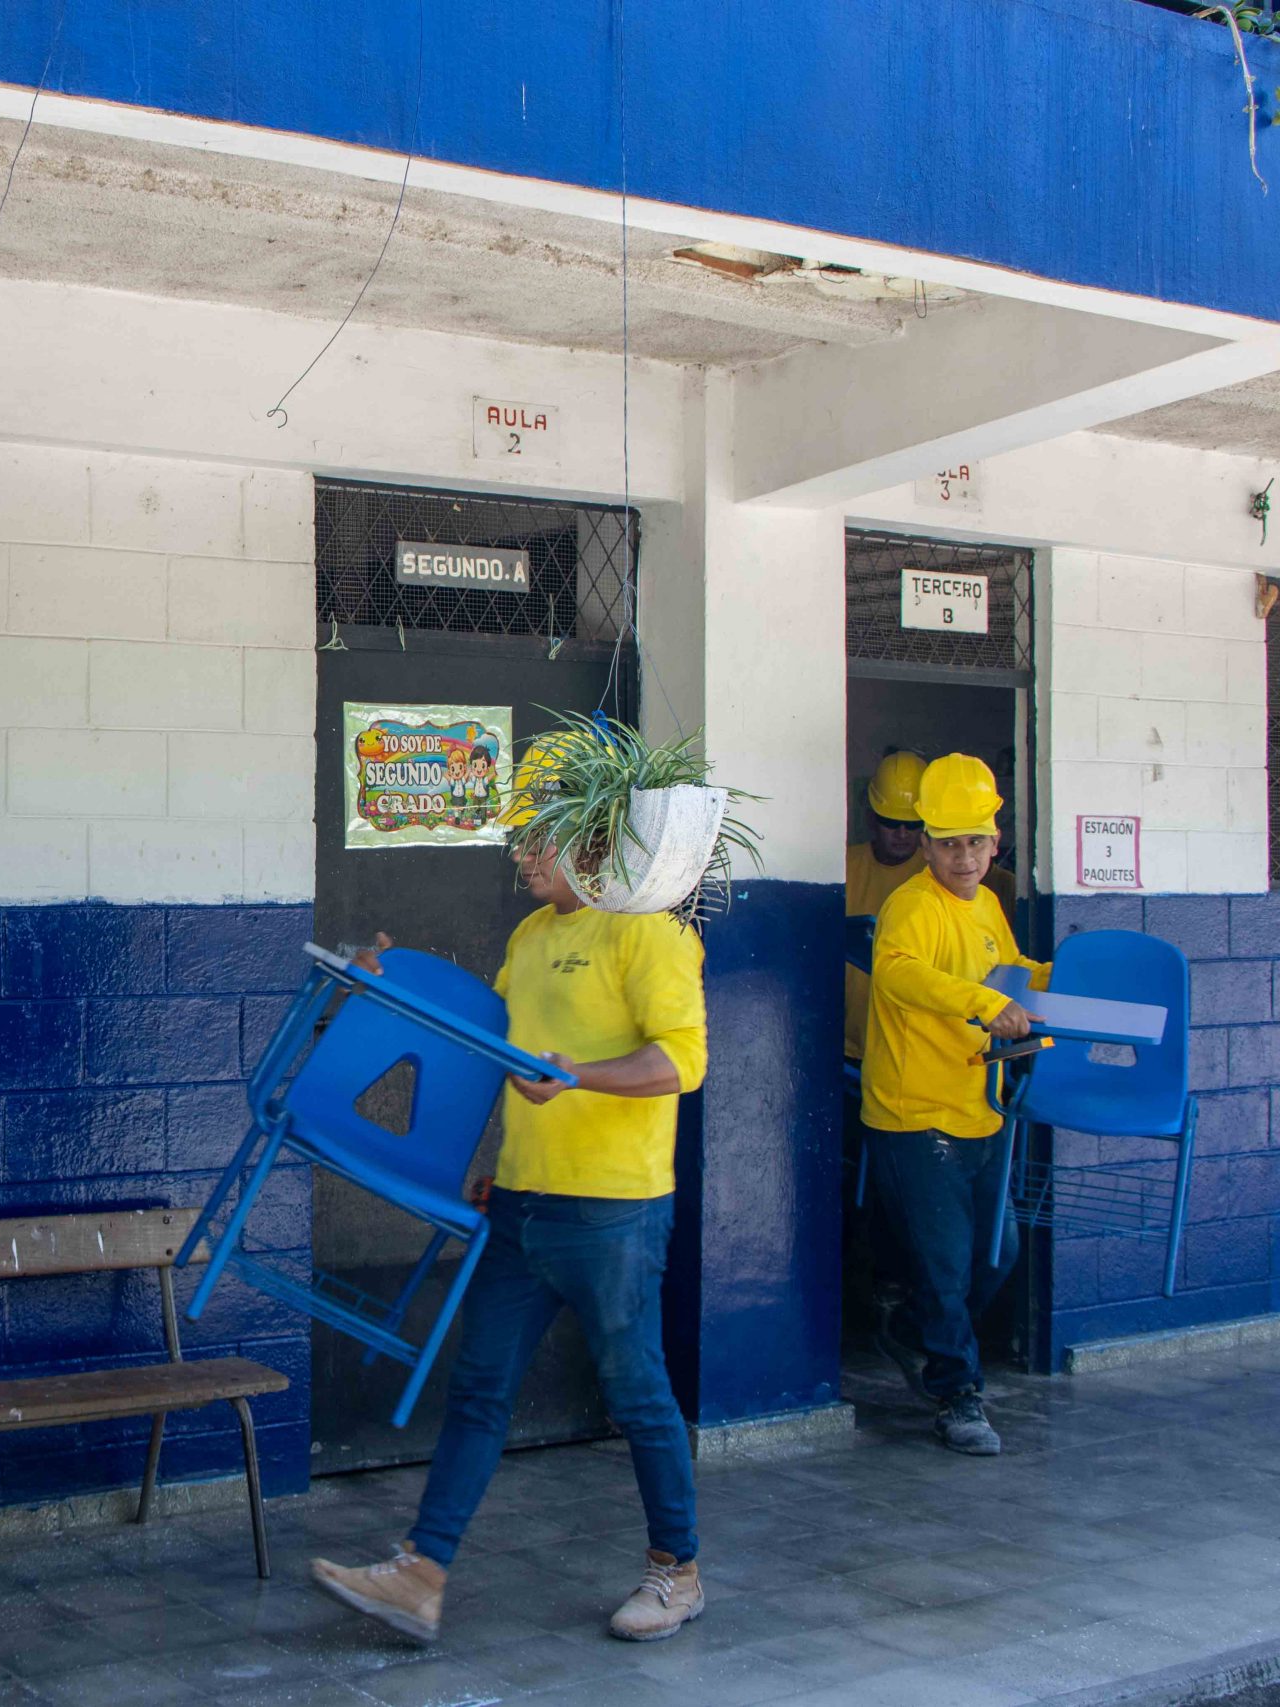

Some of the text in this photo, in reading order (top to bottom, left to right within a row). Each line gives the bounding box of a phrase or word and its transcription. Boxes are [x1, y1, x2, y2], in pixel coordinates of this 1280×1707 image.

[487, 406, 547, 431] AULA
[507, 432, 521, 454] 2
[937, 465, 969, 480] LA
[940, 480, 950, 501] 3
[912, 577, 982, 599] TERCERO
[943, 608, 953, 624] B
[383, 735, 442, 752] YO SOY DE
[365, 762, 442, 786] SEGUNDO
[1084, 820, 1133, 835] ESTACIÓN
[1105, 845, 1112, 858] 3
[1083, 868, 1135, 882] PAQUETES
